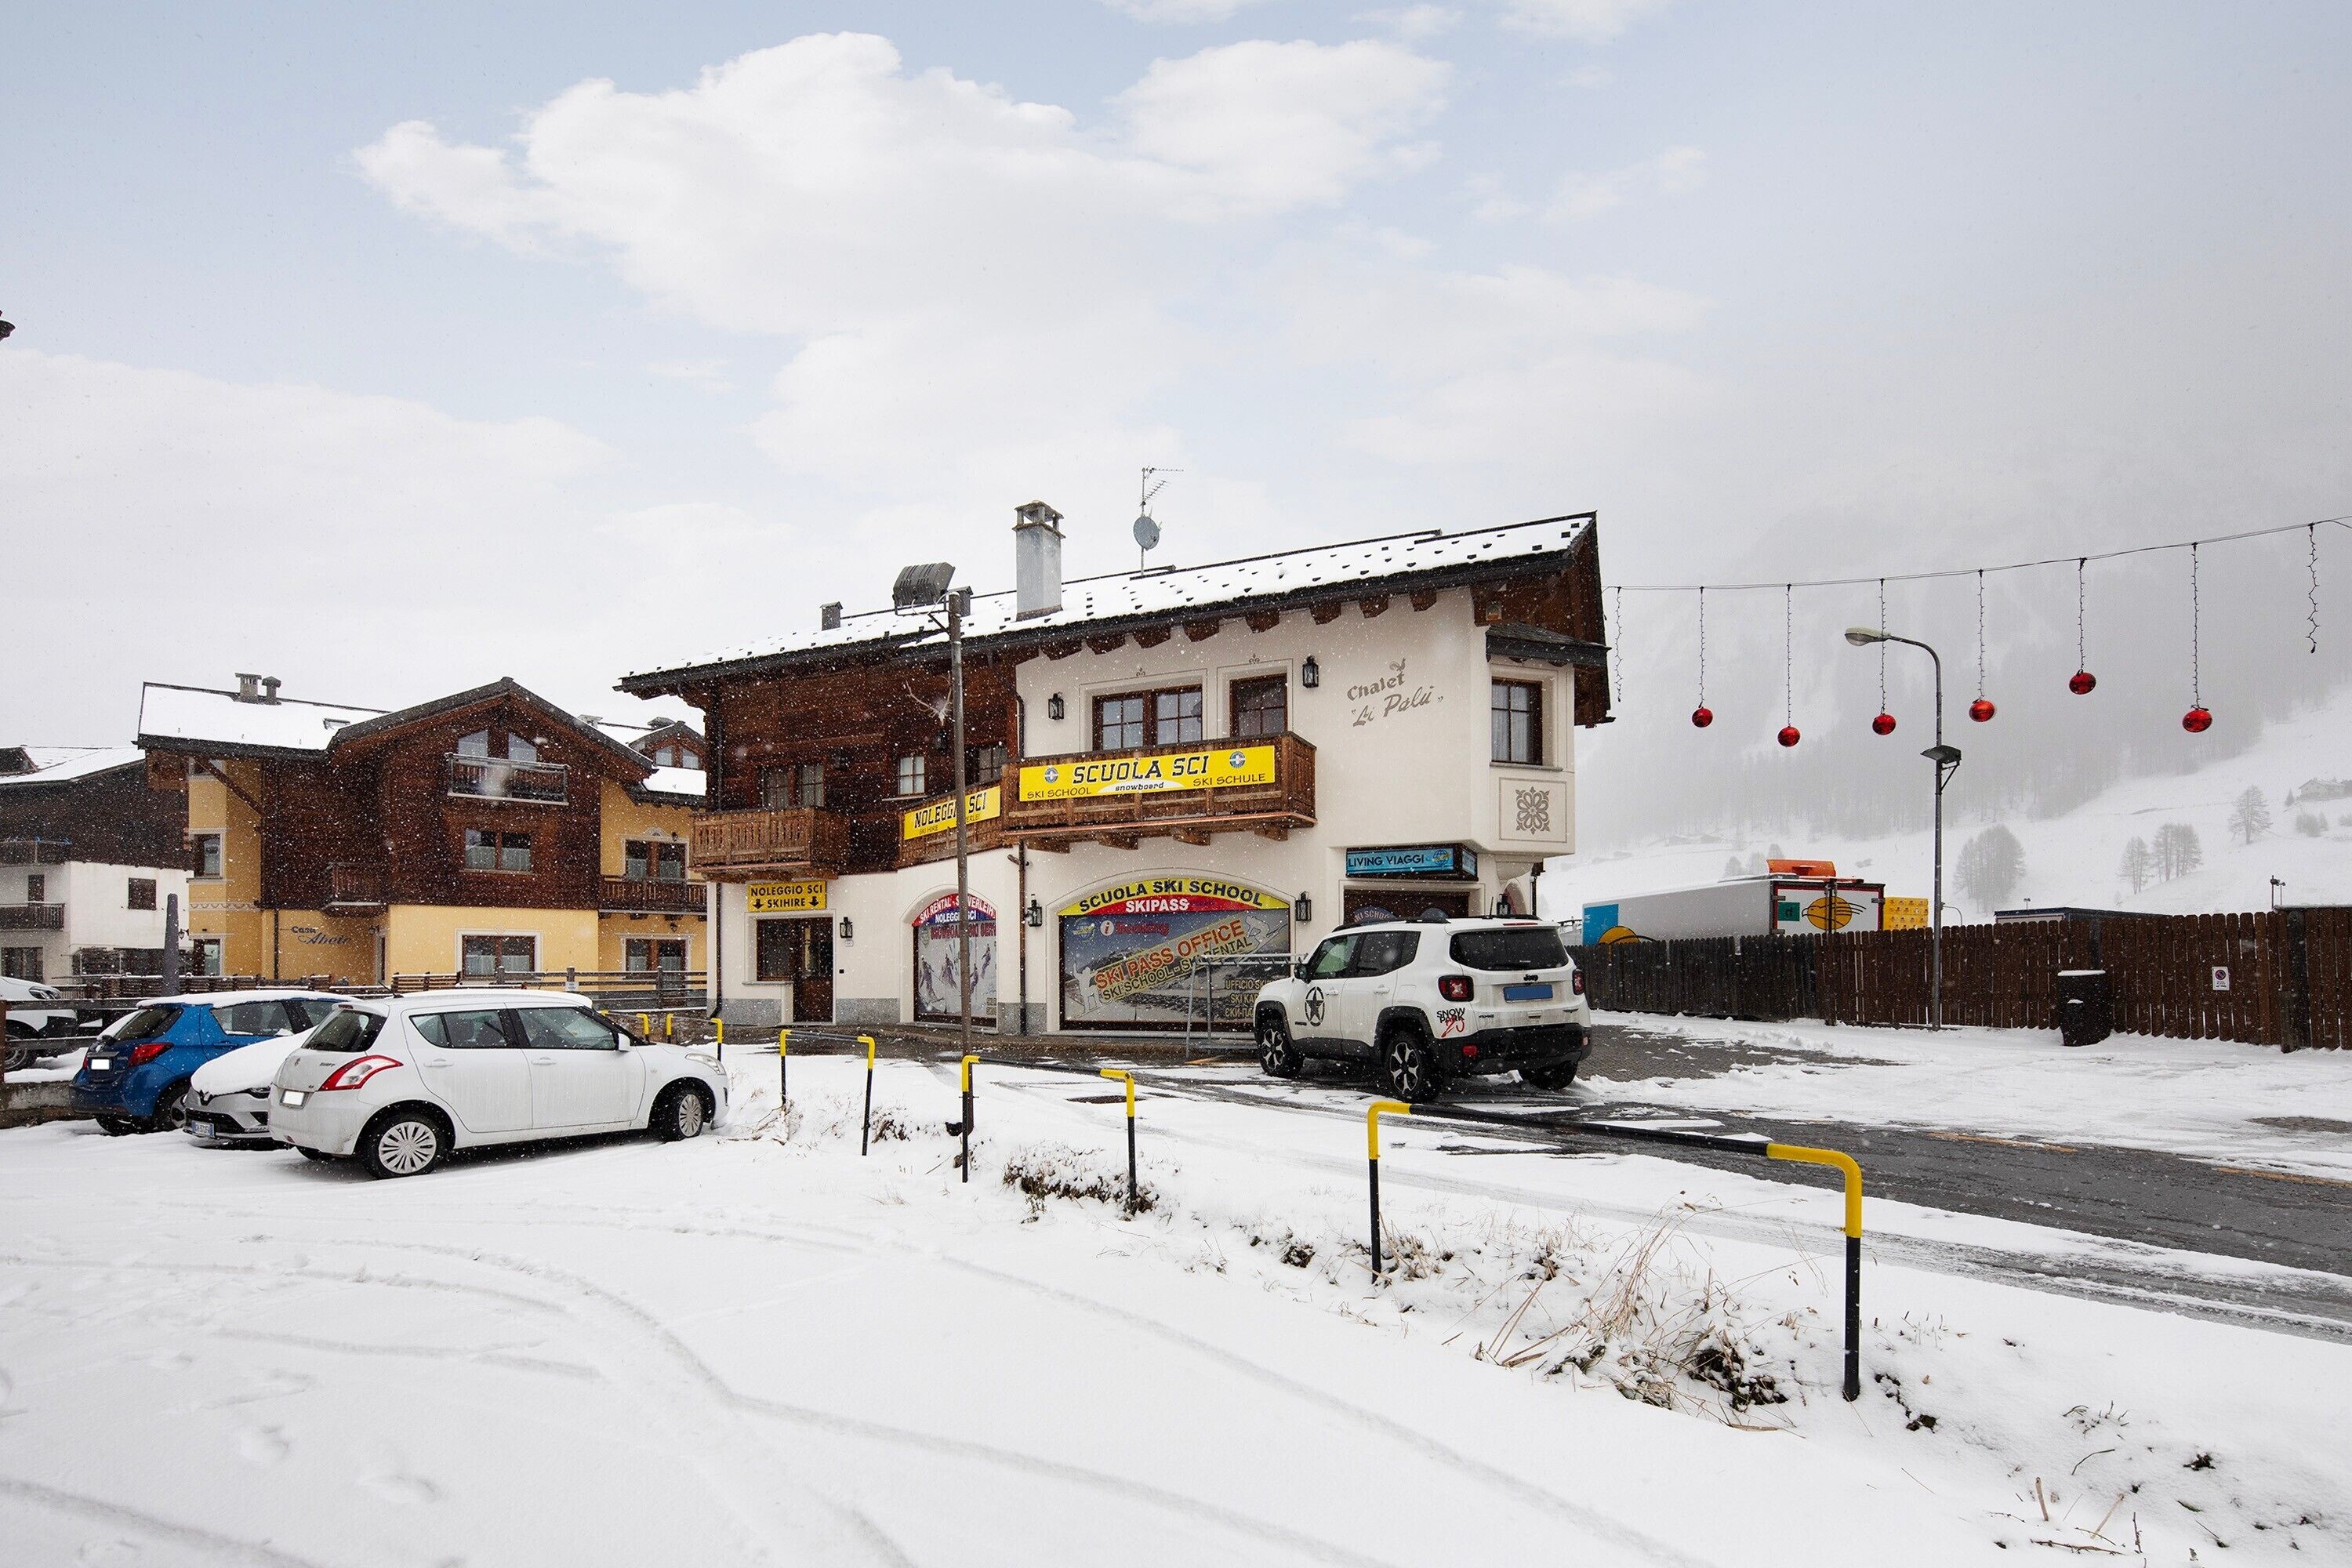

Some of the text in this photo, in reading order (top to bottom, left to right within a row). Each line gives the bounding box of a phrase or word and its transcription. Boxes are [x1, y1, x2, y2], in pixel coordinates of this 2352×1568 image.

[1347, 672, 1405, 701] Chalet
[1073, 755, 1209, 784] SCUOLA SCI
[1115, 782, 1164, 791] snowboard
[1192, 773, 1265, 786] SKI SCHULE
[1027, 786, 1092, 800] SKI SCHOOL
[914, 792, 986, 829] NOLEGGI SCI
[1348, 856, 1383, 867] LIVING
[1386, 854, 1425, 865] VIAGGI
[750, 884, 822, 897] NOLEGGIO SCI
[1079, 880, 1263, 912] SCUOLA SKI SCHOOL
[767, 898, 805, 908] SKIHIRE
[1125, 898, 1190, 913] SKIPASS
[920, 908, 930, 924] SKI
[929, 897, 952, 916] RENTAL
[1095, 919, 1244, 989] SKI PASS OFFICE
[1102, 985, 1122, 1000] SKI
[1124, 967, 1174, 993] SCHOOL
[1225, 979, 1254, 989] UFFICIO
[1230, 993, 1243, 1004] SKI
[1436, 1007, 1465, 1018] SNOW
